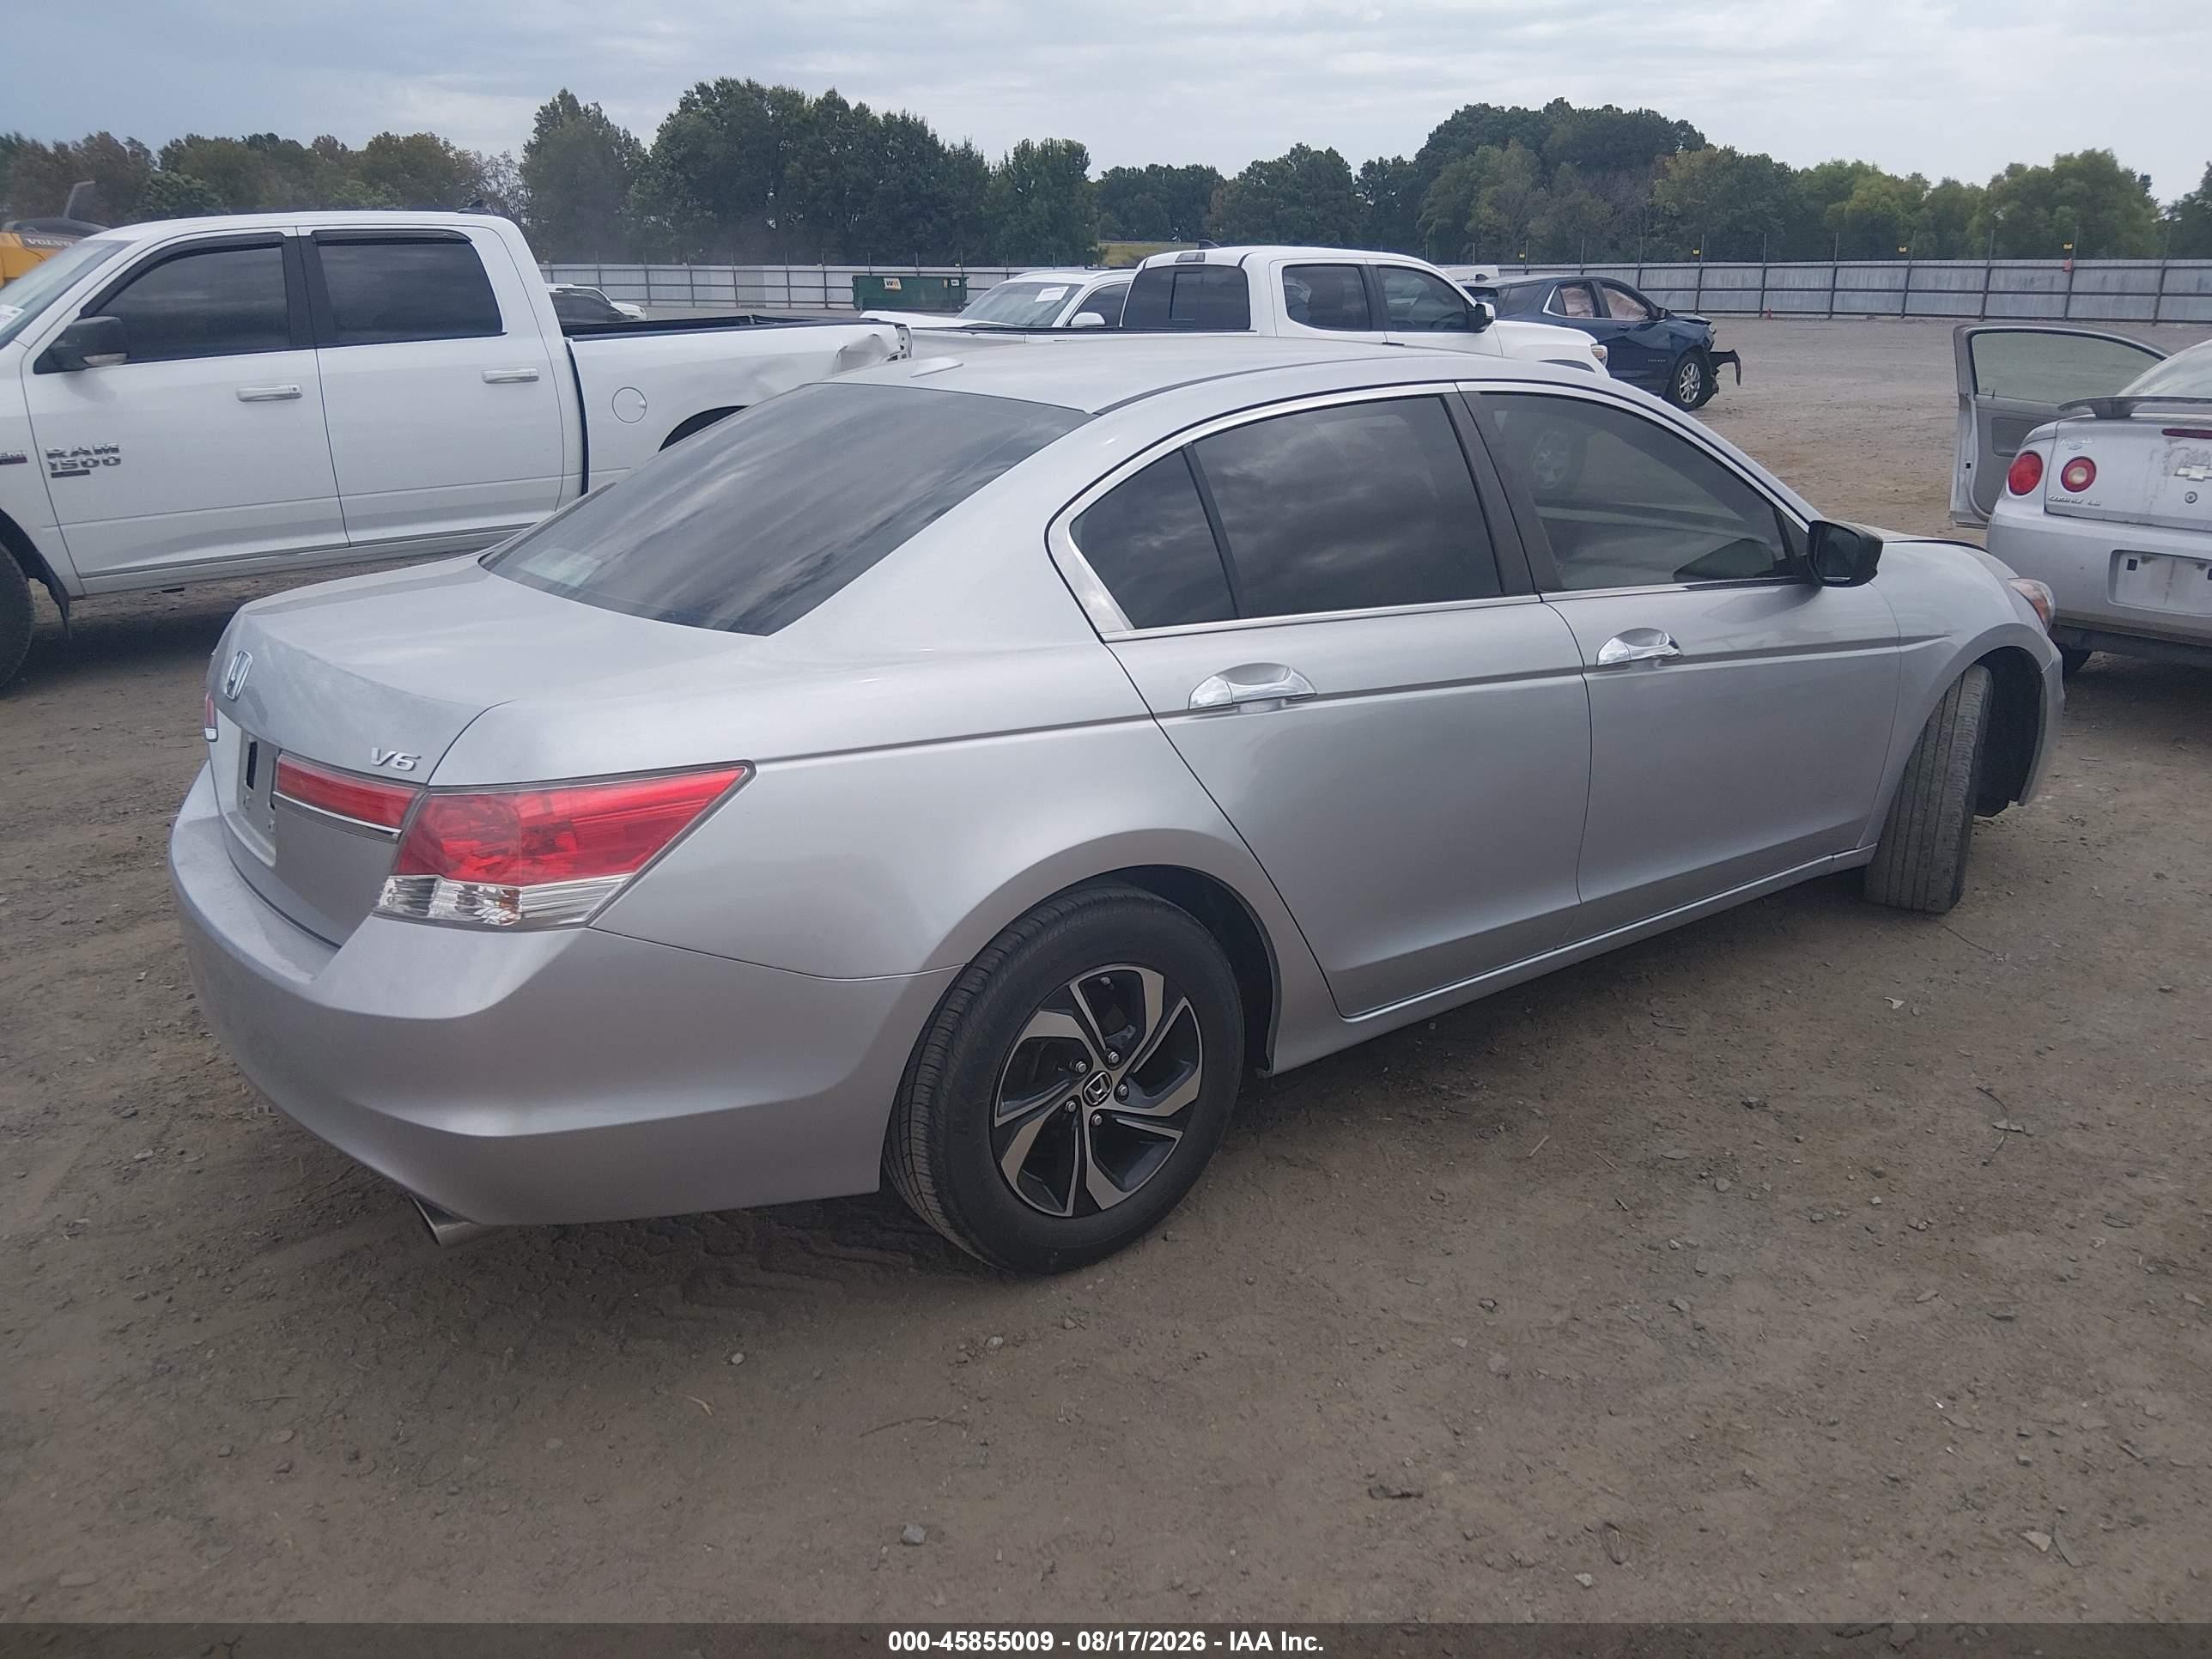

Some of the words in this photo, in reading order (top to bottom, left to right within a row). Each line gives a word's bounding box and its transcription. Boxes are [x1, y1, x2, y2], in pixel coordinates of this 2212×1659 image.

[26, 238, 76, 247] VOLVO
[46, 443, 120, 459] RAM
[48, 455, 122, 471] 1500
[371, 747, 422, 772] V6
